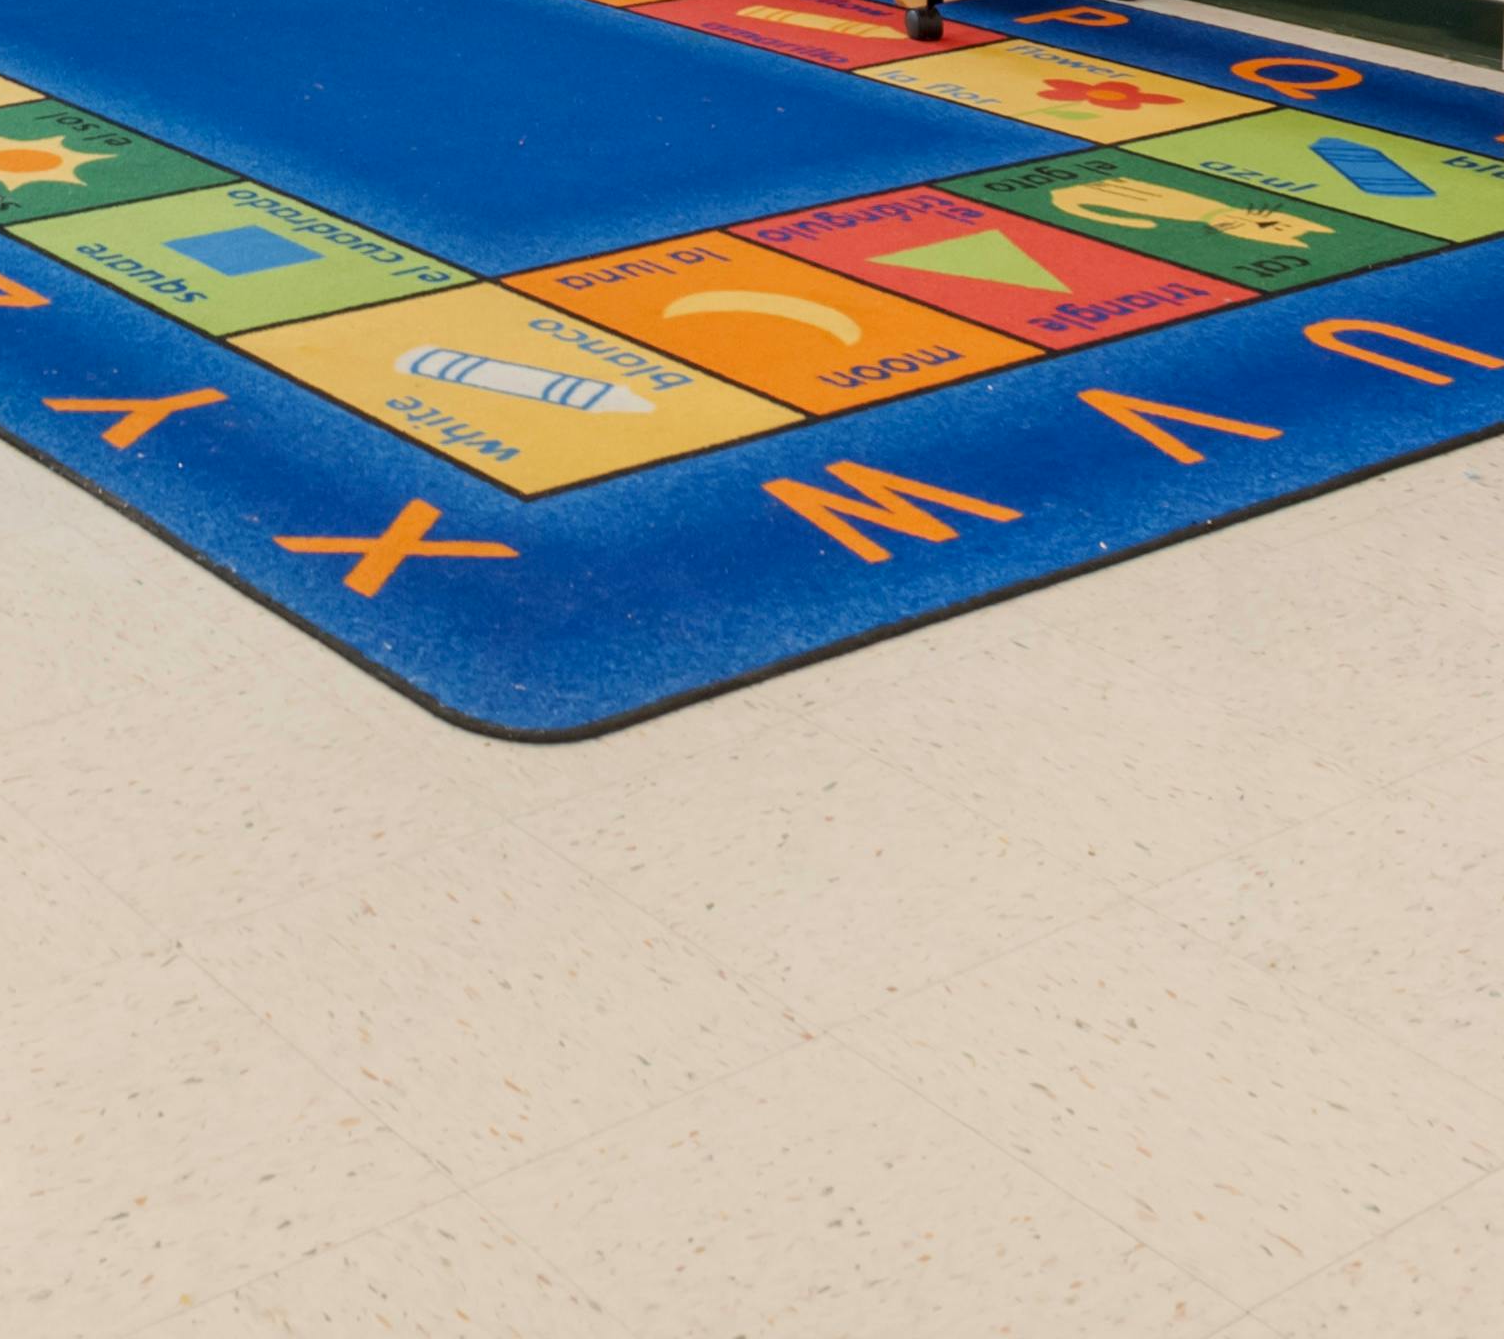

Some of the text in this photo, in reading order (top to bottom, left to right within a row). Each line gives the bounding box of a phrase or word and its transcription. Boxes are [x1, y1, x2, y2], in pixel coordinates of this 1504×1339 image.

[1003, 42, 1135, 81] flower
[1198, 156, 1320, 194] azul
[226, 187, 453, 286] el cuadrado
[75, 241, 209, 308] square
[555, 244, 733, 293] la luna
[1232, 252, 1312, 277] cat
[1028, 281, 1211, 334] triangle
[529, 316, 694, 393] blanco
[817, 343, 964, 390] moon
[385, 394, 522, 464] white
[761, 459, 1026, 564] W
